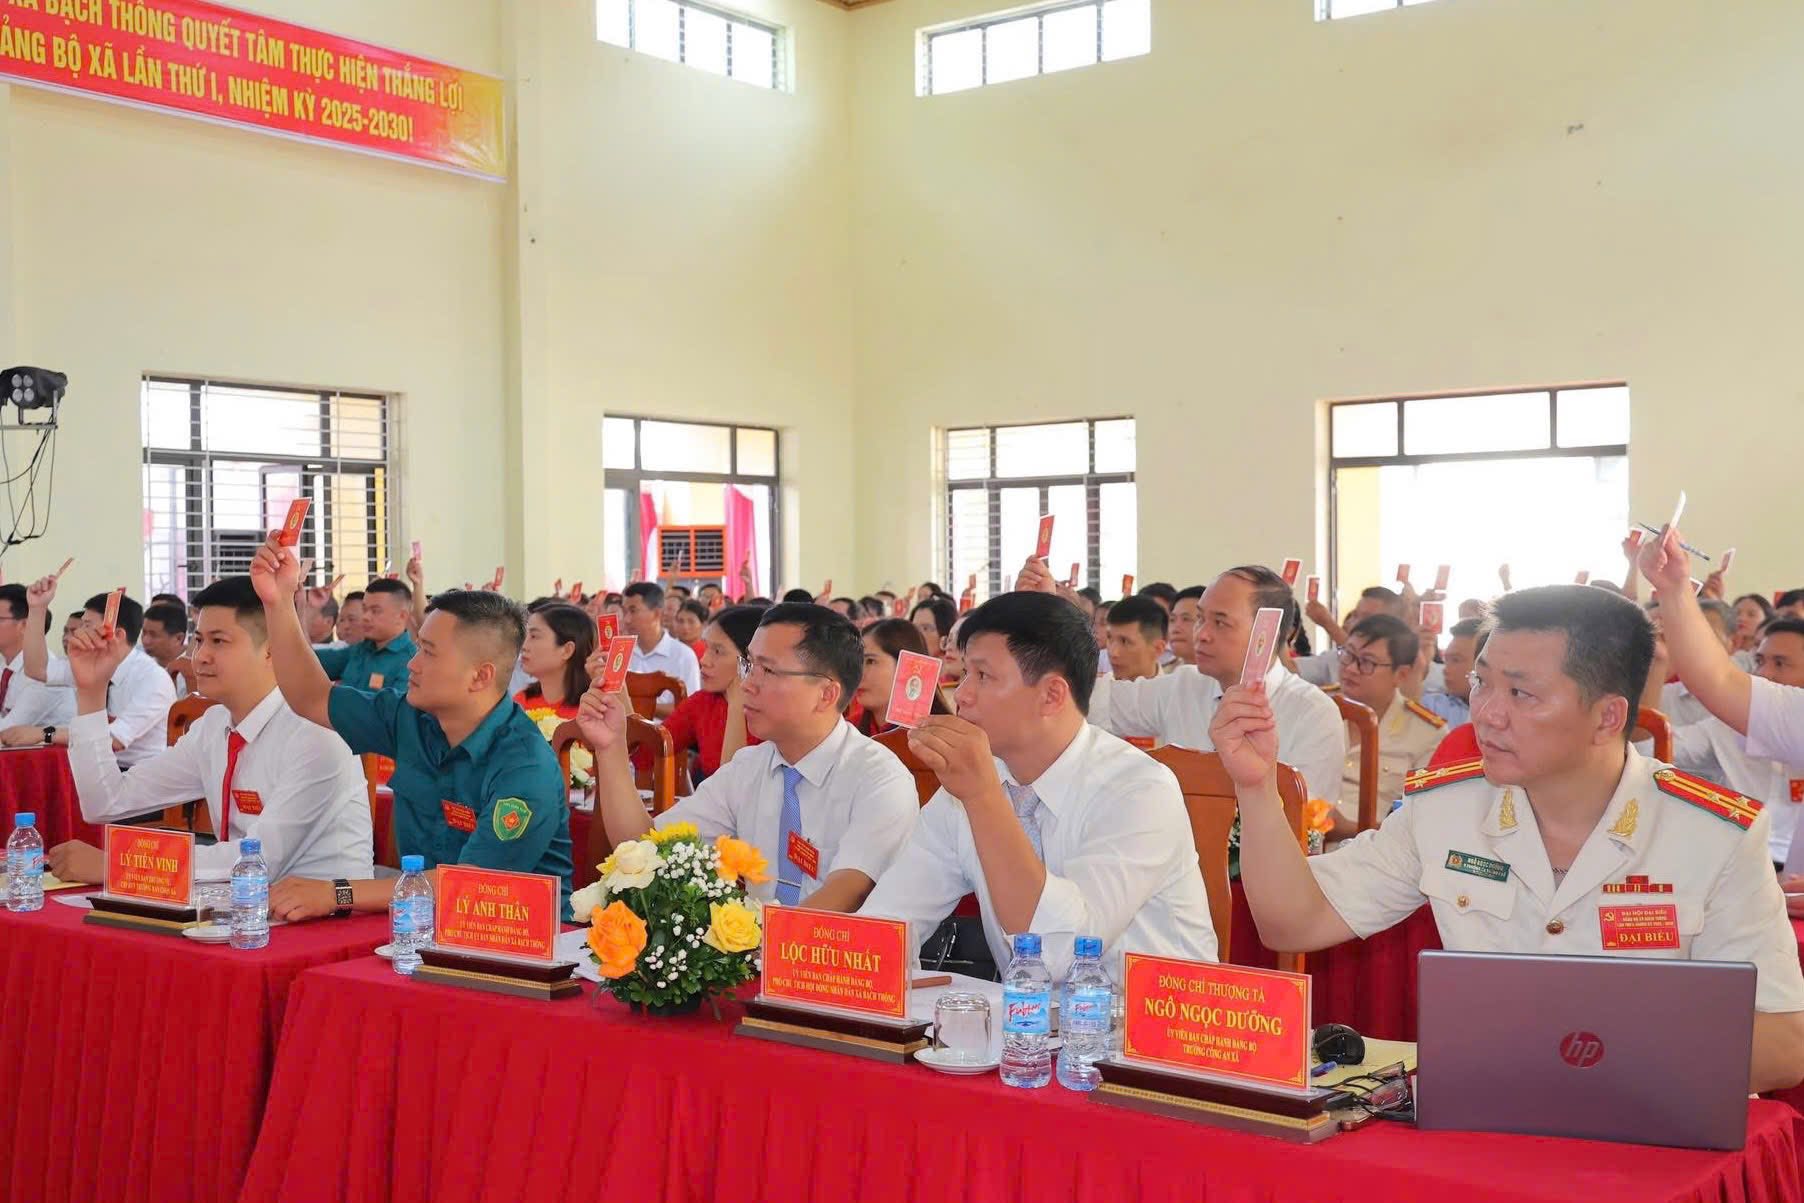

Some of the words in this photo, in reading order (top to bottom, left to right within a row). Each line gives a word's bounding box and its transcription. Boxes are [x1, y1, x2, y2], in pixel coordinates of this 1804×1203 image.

[109, 0, 176, 43] THÔNG
[182, 17, 240, 58] QUYẾT
[246, 29, 285, 68] TÂM
[290, 43, 334, 84] THỰC
[339, 54, 378, 94] HIỆN
[383, 62, 435, 104] THẮNG
[440, 79, 464, 114] LỢI
[52, 34, 82, 78] BỘ
[88, 43, 117, 79] XÃ
[122, 45, 163, 89] LẦN
[168, 63, 206, 98] THỨ
[228, 75, 289, 118] NHIỆM
[293, 88, 316, 121] KỲ
[321, 98, 414, 143] 2025-2030!
[120, 849, 133, 867] LÝ
[133, 852, 154, 869] TIẾN
[156, 857, 178, 873] VINH
[473, 900, 496, 918] ANH
[498, 900, 529, 921] THÂN
[1619, 932, 1641, 944] ĐẠI
[1645, 930, 1674, 942] BIỂU
[780, 941, 807, 965] LỘC
[811, 944, 839, 967] HỮU
[843, 946, 881, 973] NHẤT
[1208, 982, 1250, 1001] THƯỢNG
[1144, 995, 1176, 1019] NGÔ
[1180, 1003, 1222, 1029] NGỌC
[1226, 1009, 1282, 1036] DƯỠNG
[1565, 1032, 1600, 1068] hp
